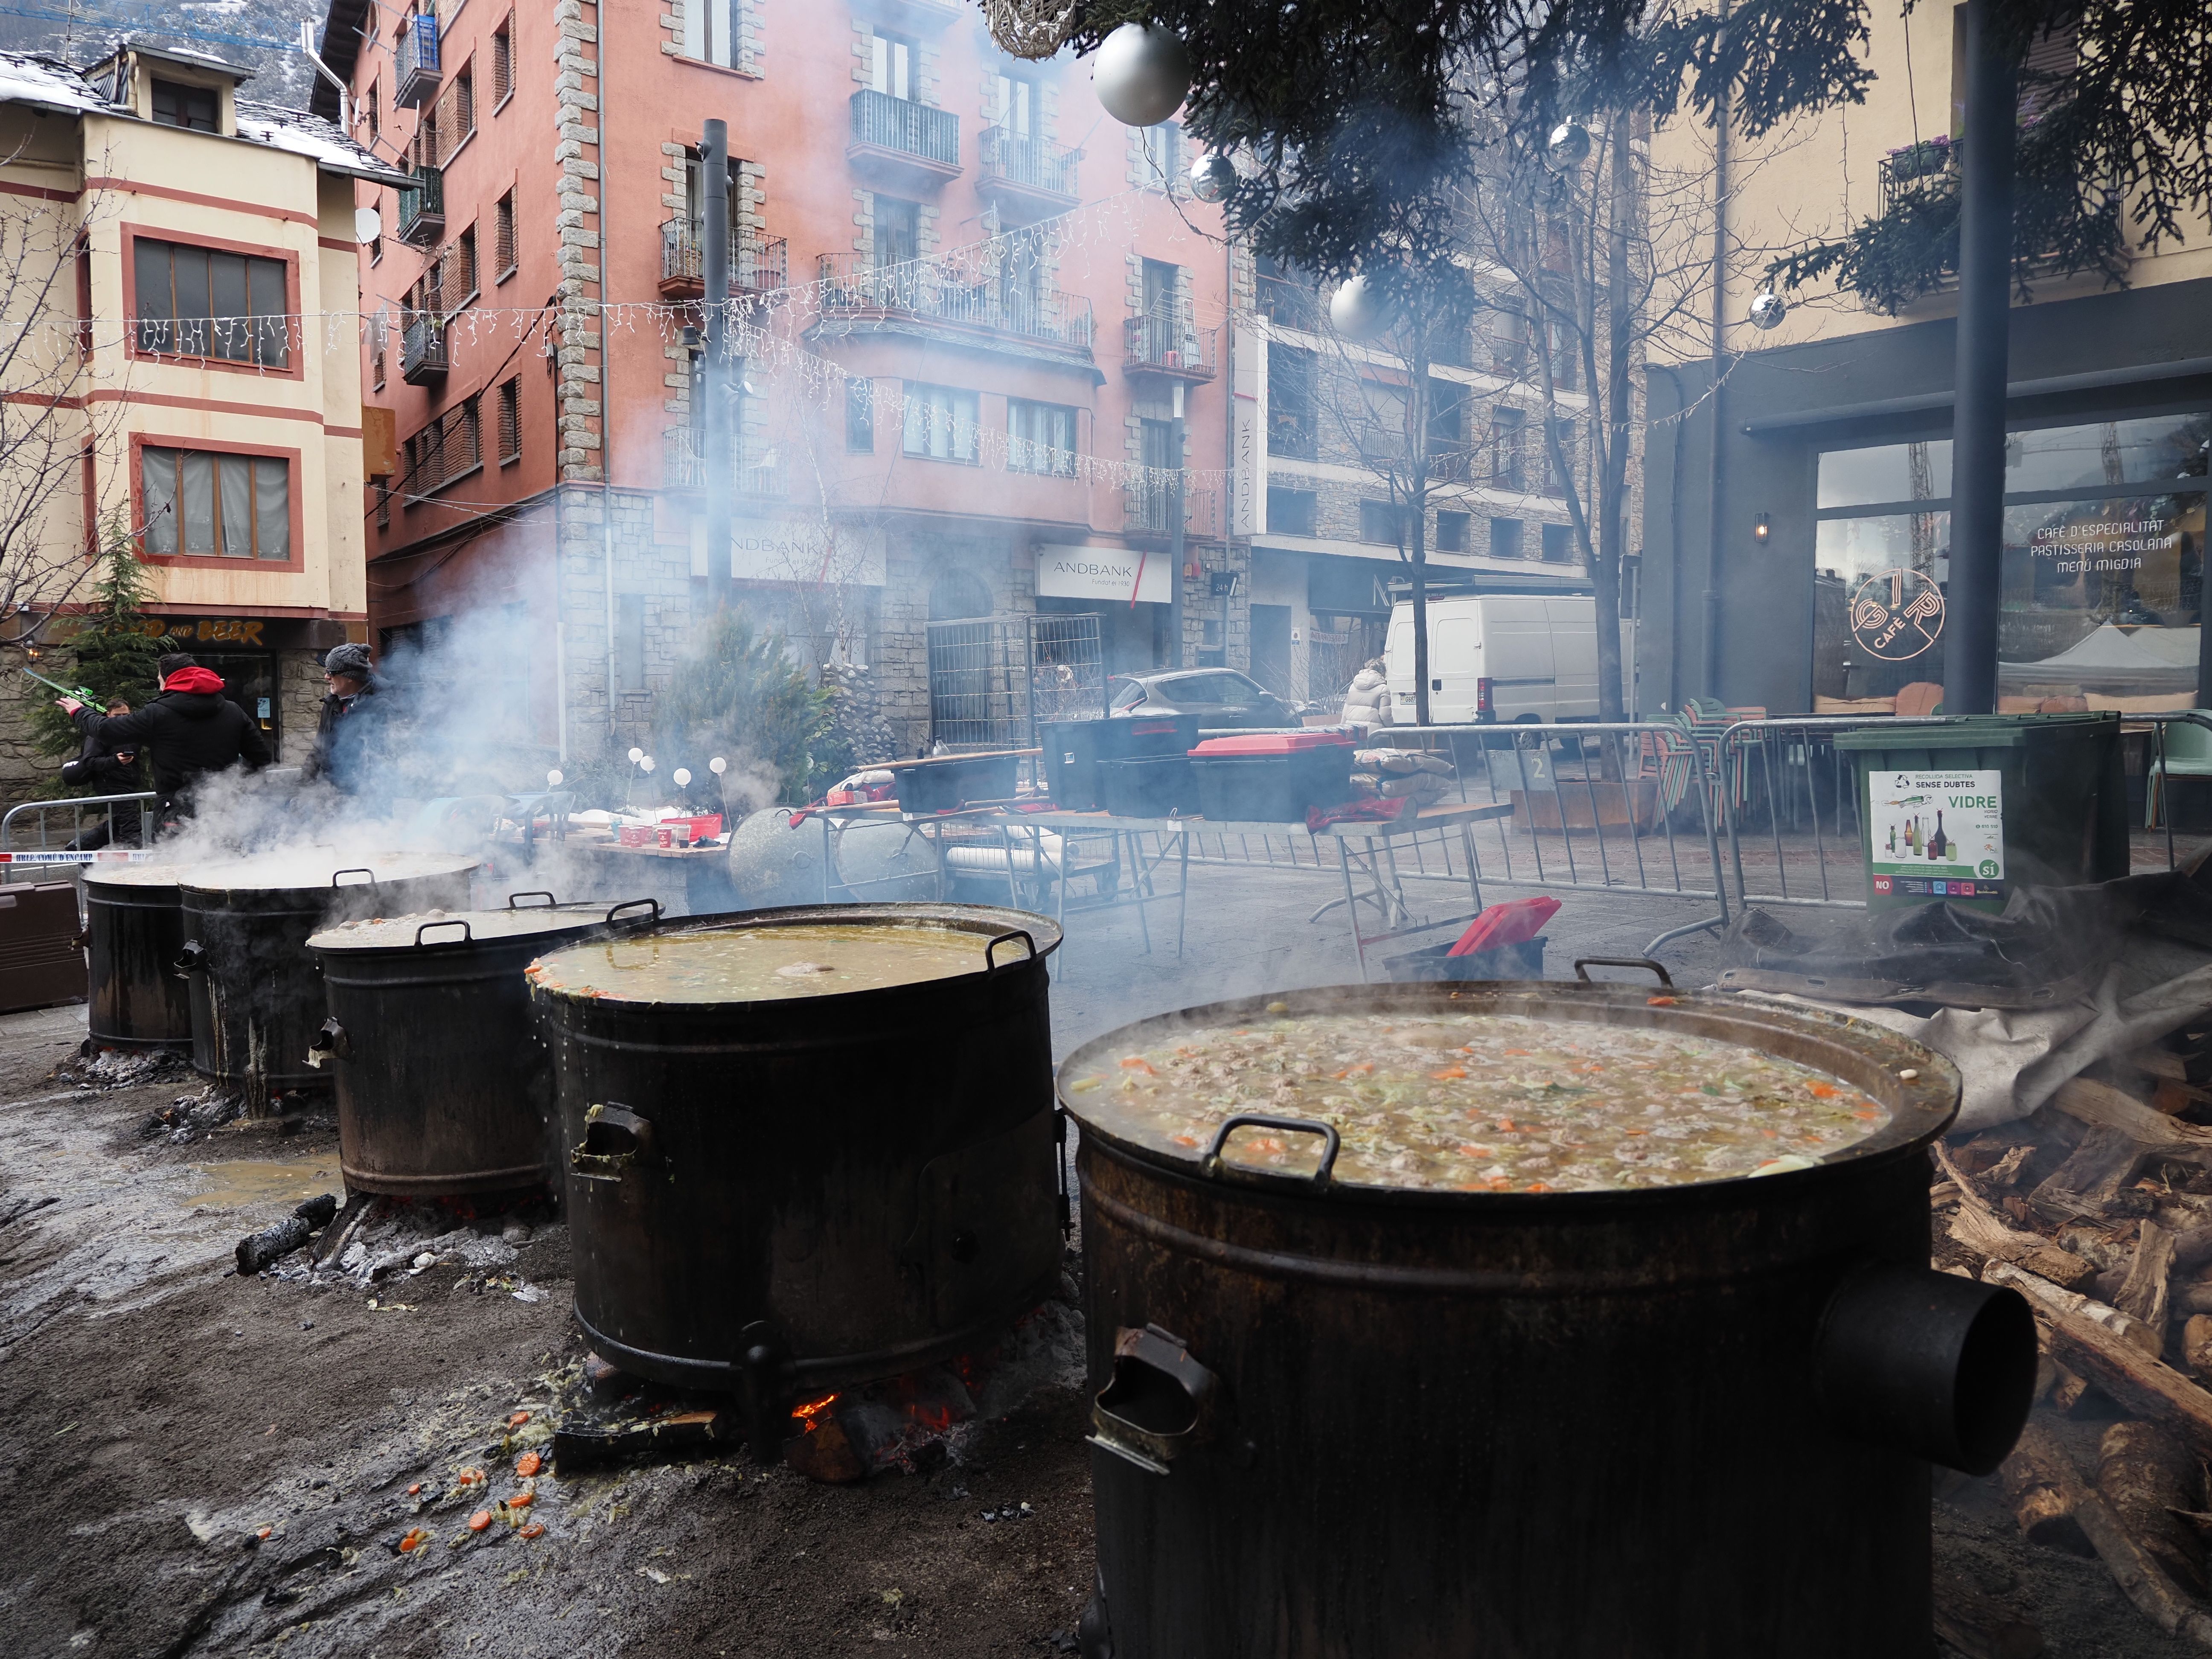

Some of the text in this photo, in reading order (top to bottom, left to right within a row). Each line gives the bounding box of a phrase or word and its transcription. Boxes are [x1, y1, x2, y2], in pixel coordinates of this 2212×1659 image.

[1241, 419, 1250, 528] ANDBANK
[2071, 520, 2164, 537] D'ESPECIALITAT
[731, 537, 819, 555] NDBANK
[2031, 537, 2172, 556] PASTISSERIA CASOLANA
[1054, 562, 1132, 577] ANDBANK
[170, 625, 194, 637] AND
[198, 620, 263, 646] BEER
[1532, 758, 1545, 778] 2
[1948, 796, 1997, 808] VIDRE
[1982, 862, 1995, 875] sí
[1876, 881, 1889, 890] NO
